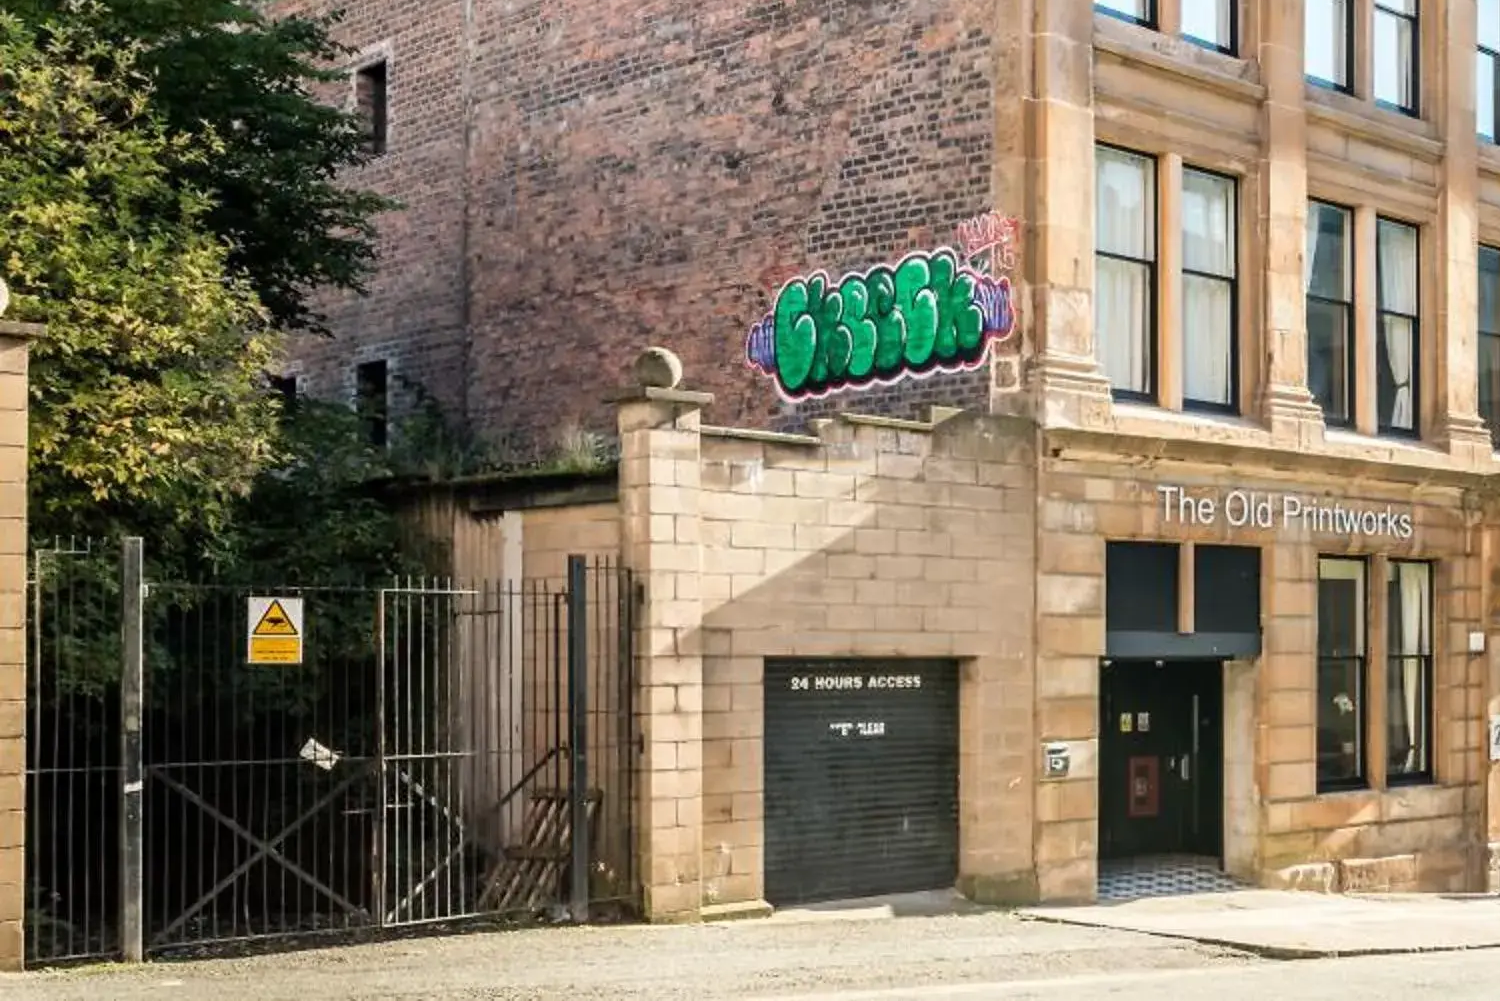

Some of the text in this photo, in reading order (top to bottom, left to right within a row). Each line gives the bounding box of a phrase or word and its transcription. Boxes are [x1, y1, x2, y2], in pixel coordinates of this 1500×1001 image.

[1157, 485, 1413, 539] The Old Printworks
[790, 674, 921, 690] 24 HOURS ACCESS
